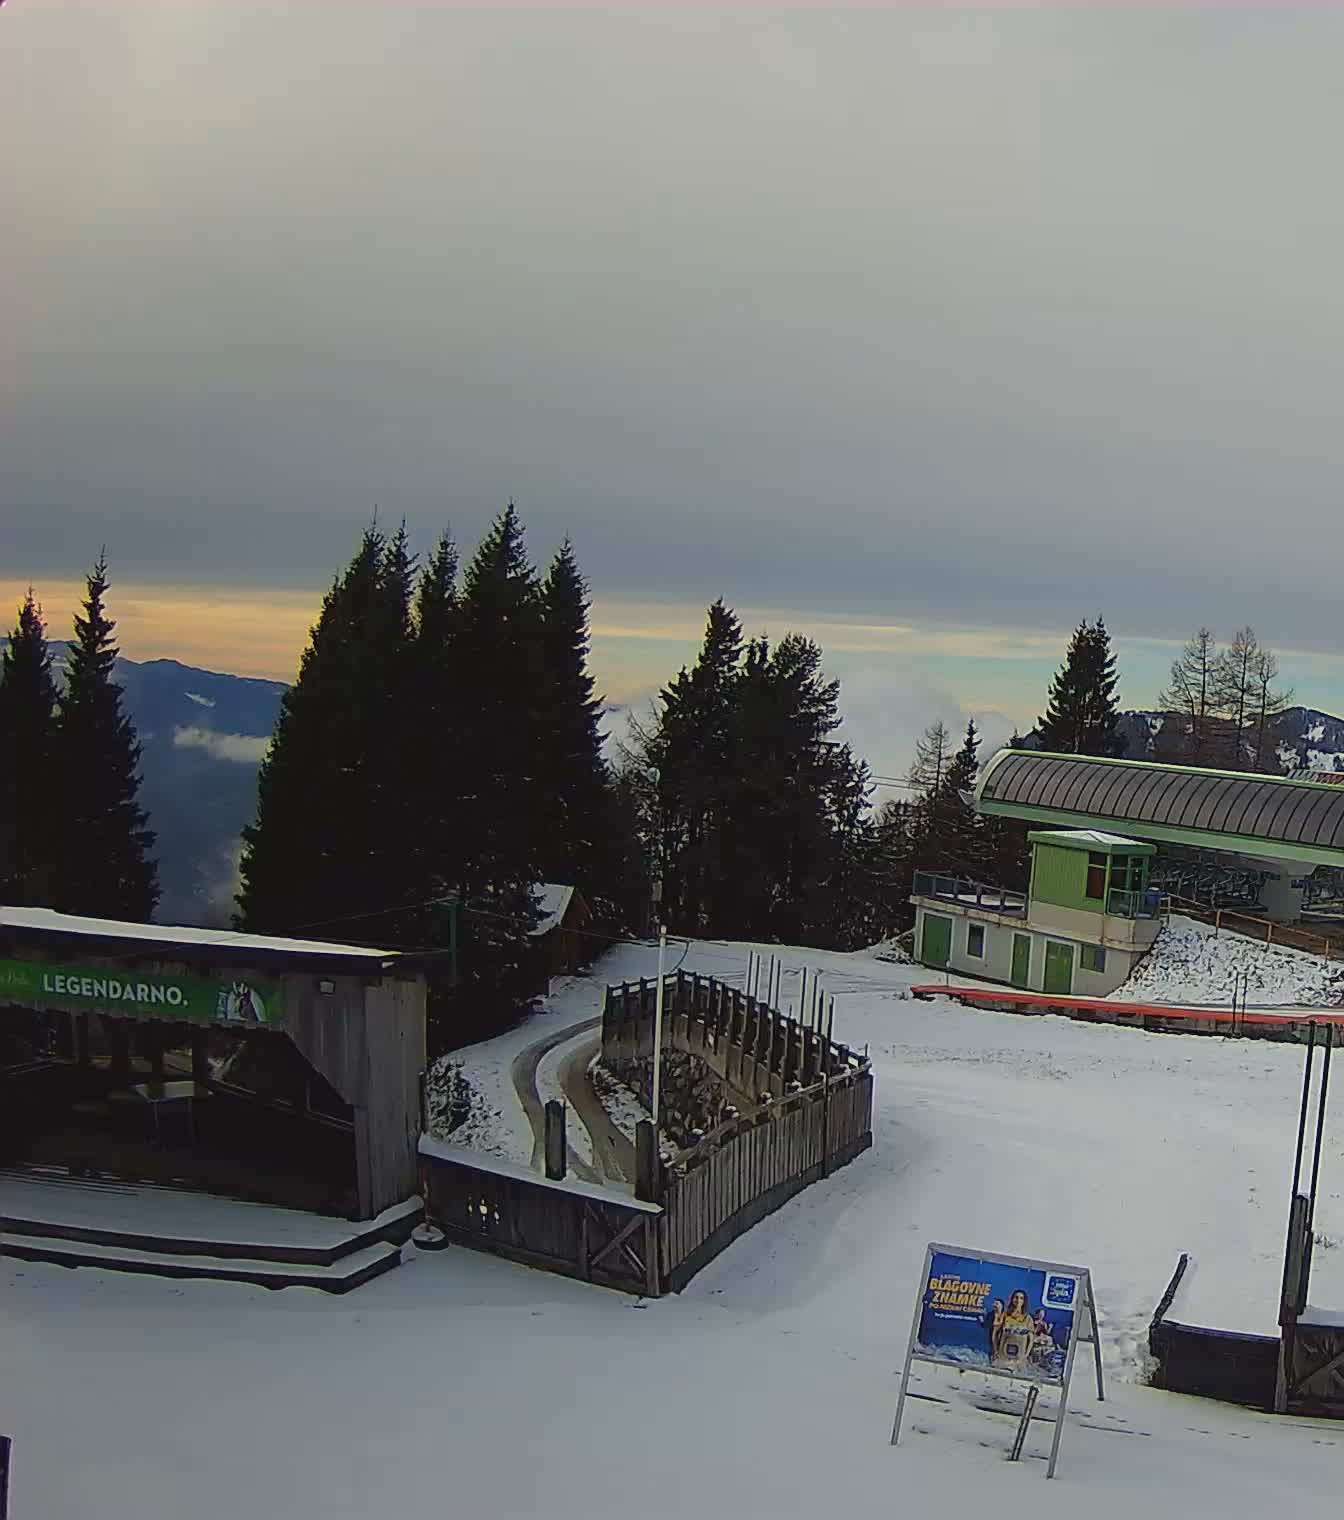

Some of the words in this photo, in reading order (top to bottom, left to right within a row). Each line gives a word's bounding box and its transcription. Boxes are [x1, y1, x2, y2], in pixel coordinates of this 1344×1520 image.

[43, 973, 189, 1007] LEGENDARNO.
[929, 1278, 992, 1296] BLAGOVNE
[932, 1291, 985, 1307] ZNAMKE
